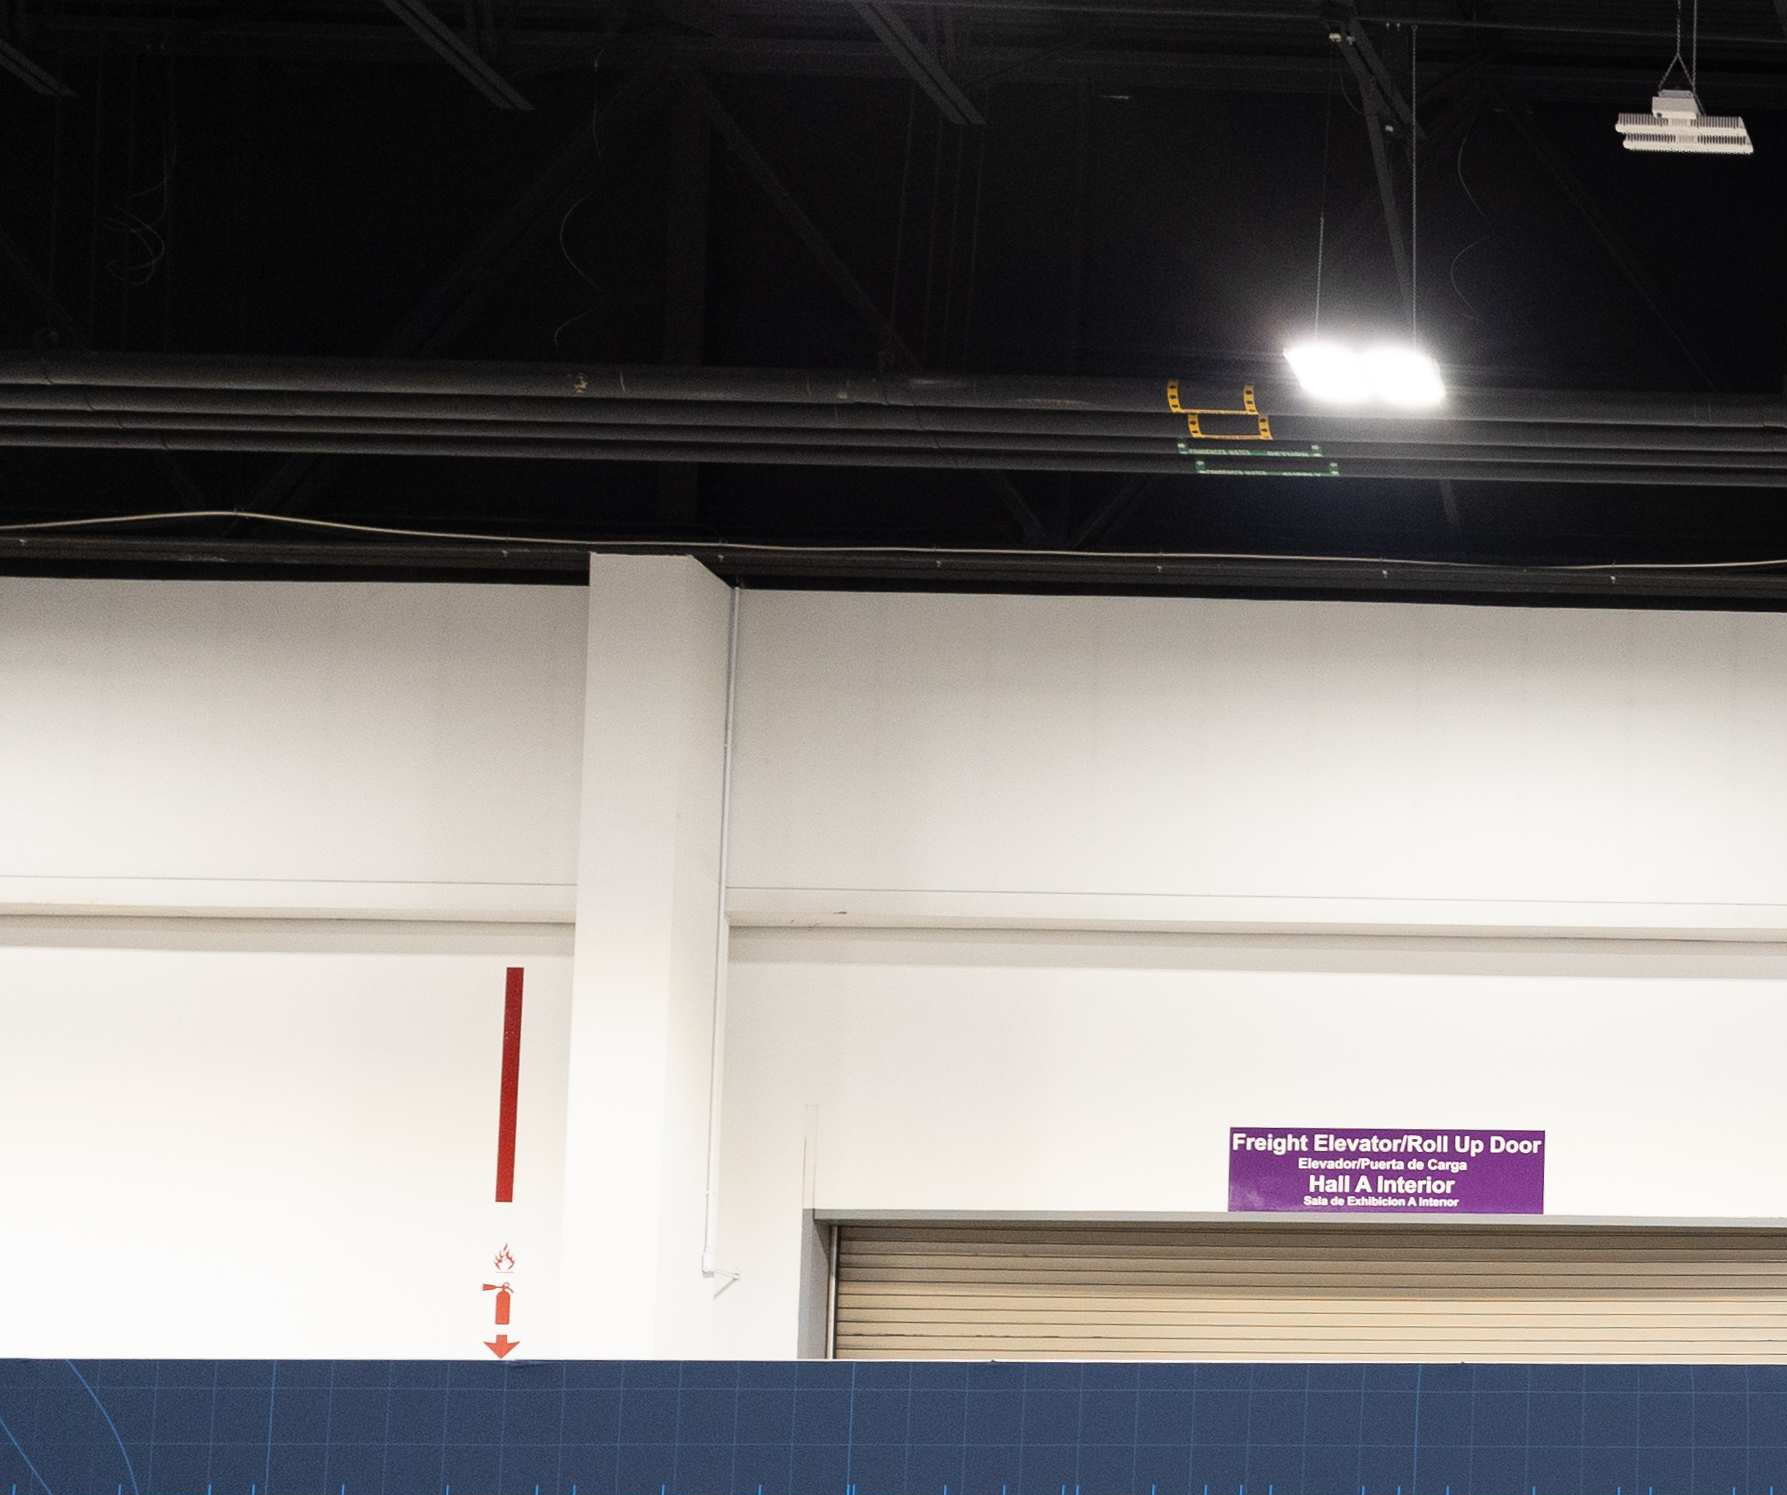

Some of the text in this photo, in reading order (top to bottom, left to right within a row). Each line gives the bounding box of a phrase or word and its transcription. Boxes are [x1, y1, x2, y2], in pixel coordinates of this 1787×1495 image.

[1232, 1133, 1542, 1157] Freight Elevator/Roll Up Door
[1298, 1157, 1467, 1172] Elevador/Puerta de Carga
[1309, 1175, 1455, 1194] Hall A Interior
[1303, 1195, 1328, 1206] Sala
[1330, 1196, 1345, 1206] de
[1408, 1197, 1417, 1207] A
